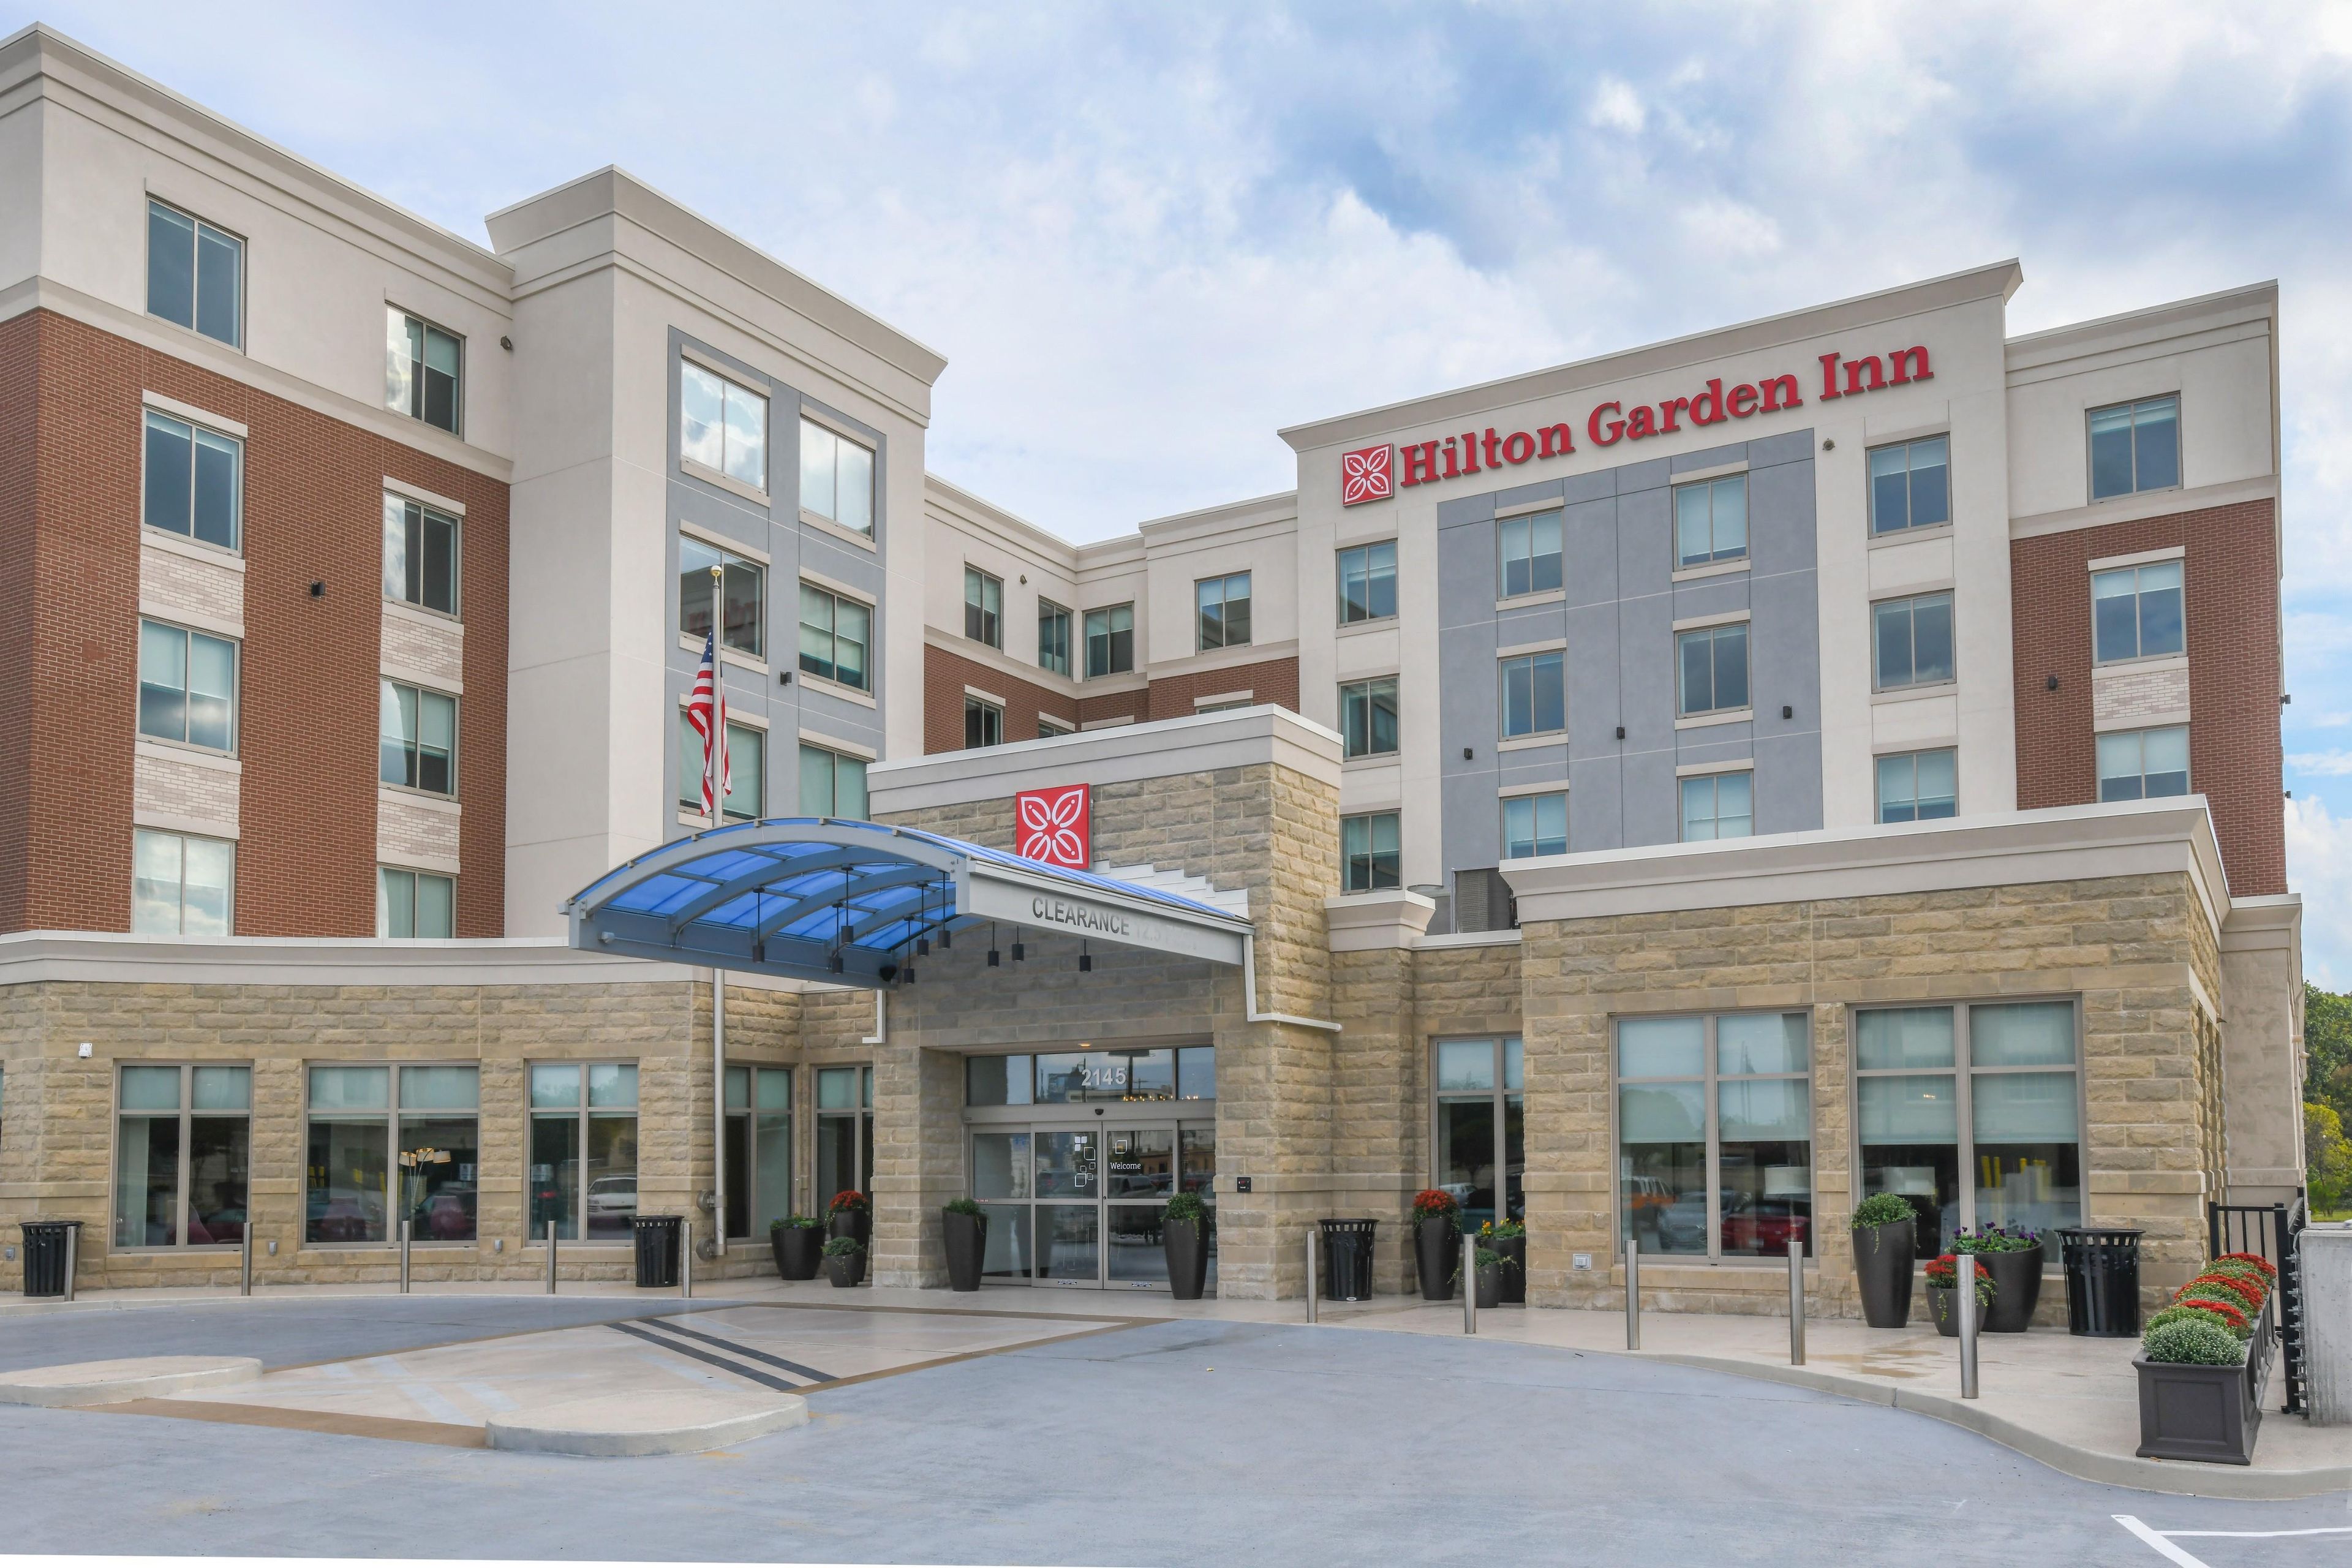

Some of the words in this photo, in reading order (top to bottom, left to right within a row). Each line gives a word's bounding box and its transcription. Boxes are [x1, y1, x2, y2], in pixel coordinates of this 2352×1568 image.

[1400, 423, 1575, 488] Hilton
[1587, 374, 1803, 447] Garden
[1818, 344, 1934, 402] Inn
[1032, 897, 1130, 937] CLEARANCE
[1081, 1067, 1127, 1086] 2145
[1110, 1161, 1141, 1170] Welcome
